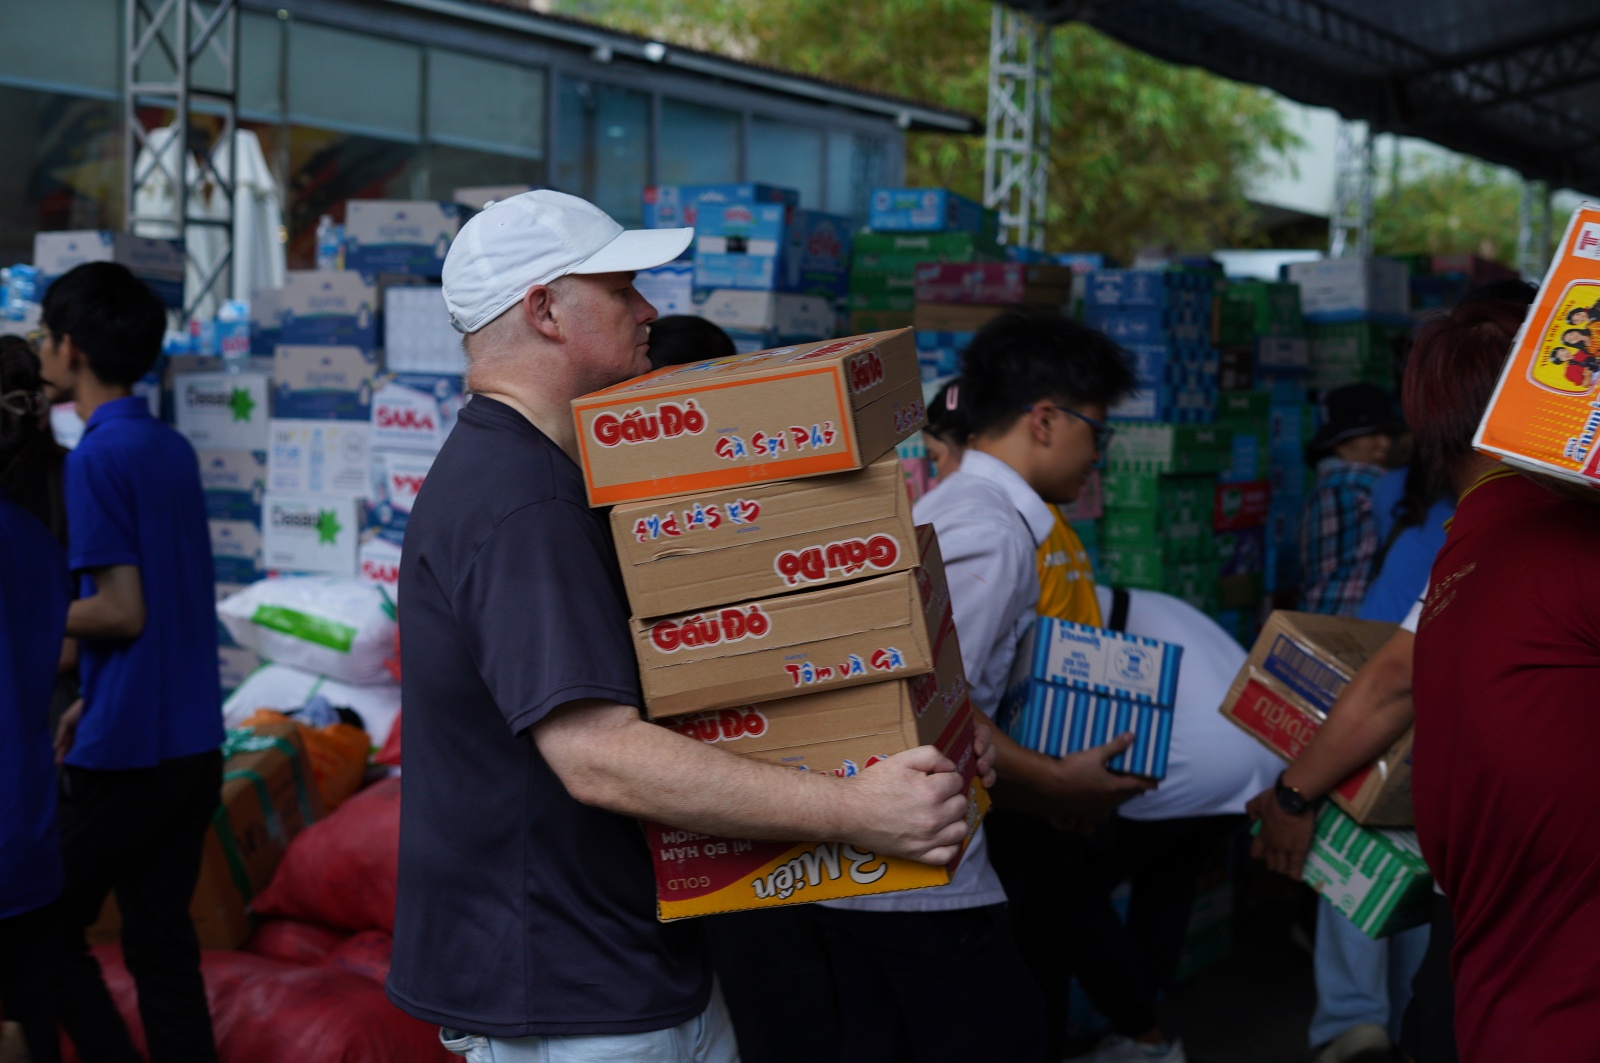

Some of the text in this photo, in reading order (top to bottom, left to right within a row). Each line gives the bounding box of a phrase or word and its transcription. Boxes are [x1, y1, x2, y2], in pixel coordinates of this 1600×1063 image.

[713, 421, 839, 460] Gà Sợi Phở
[726, 500, 762, 525] Gà
[784, 647, 905, 688] Tôm và Gà
[703, 842, 729, 859] BÒ
[729, 839, 753, 856] MÌ
[667, 875, 711, 891] GOLD
[751, 842, 844, 900] Miền
